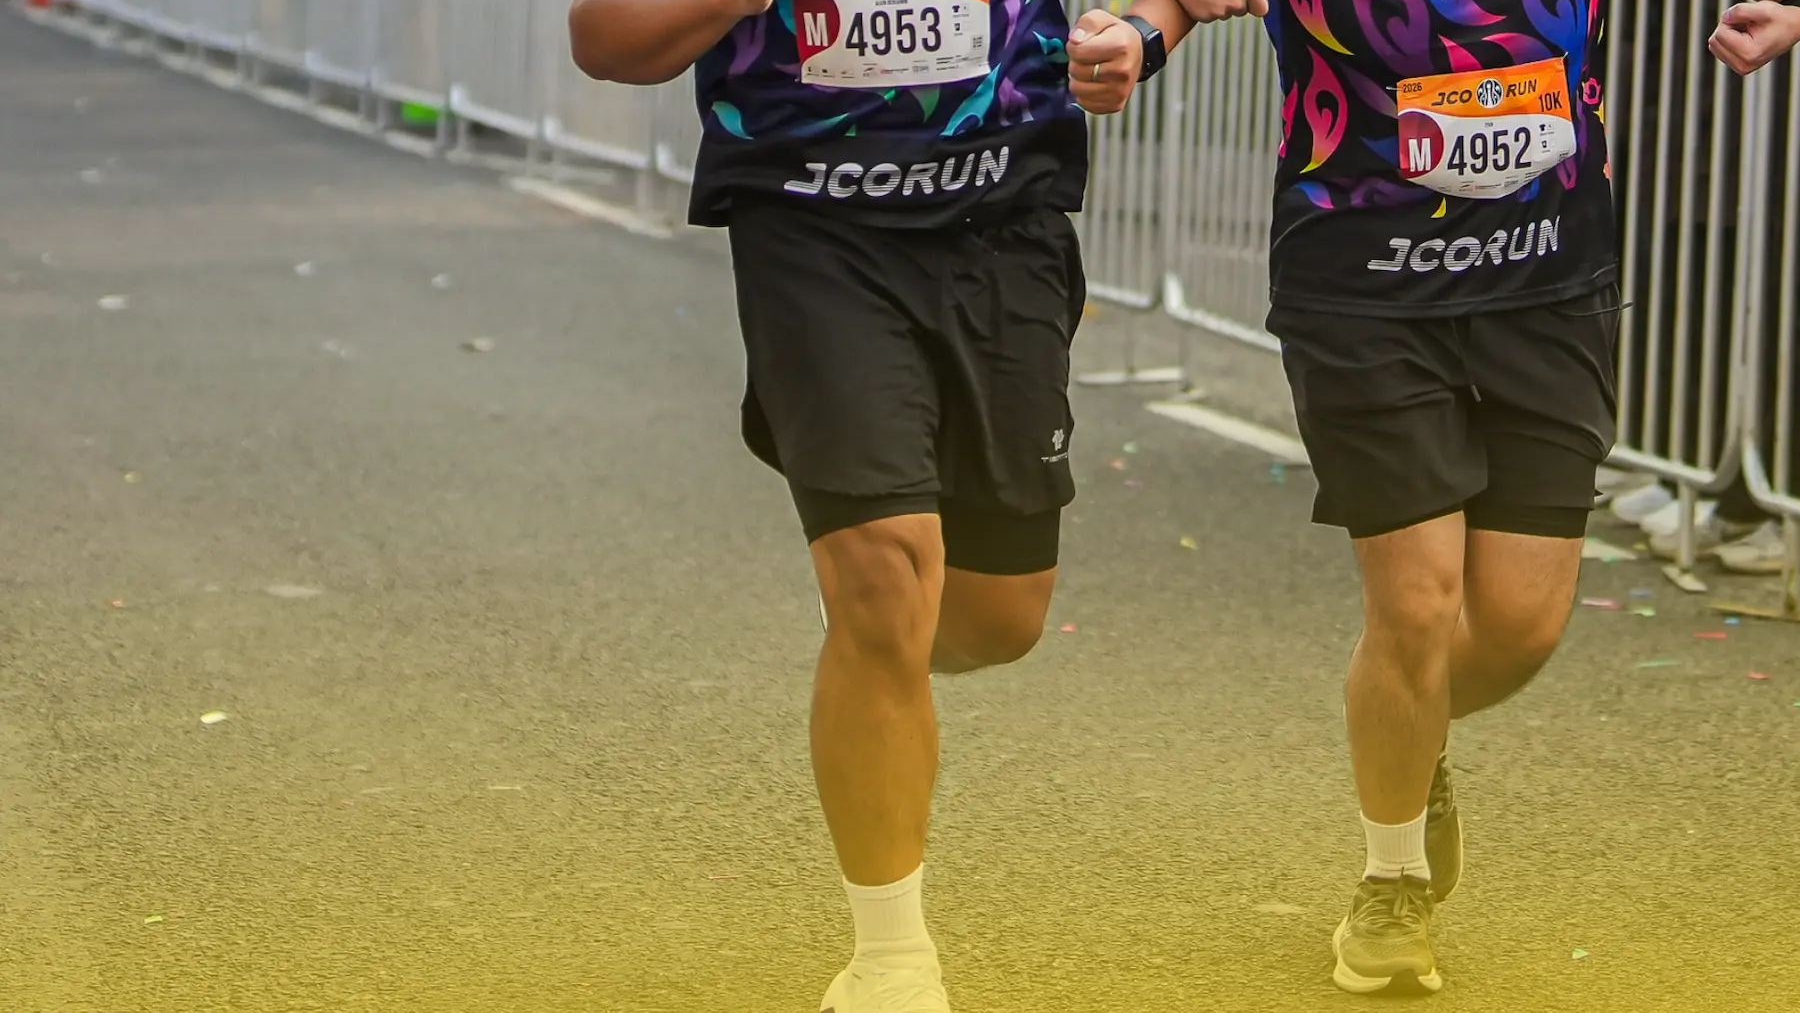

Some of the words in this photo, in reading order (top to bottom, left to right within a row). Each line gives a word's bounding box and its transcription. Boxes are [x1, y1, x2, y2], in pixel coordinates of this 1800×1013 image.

[803, 11, 829, 47] M
[845, 6, 942, 57] 4953
[1431, 89, 1473, 106] JCO
[1506, 79, 1537, 98] RUN
[1538, 91, 1563, 113] 10K
[783, 146, 1010, 199] JCORUN
[1408, 137, 1432, 173] M
[1447, 126, 1532, 176] 4952
[1367, 215, 1561, 273] JCORUN
